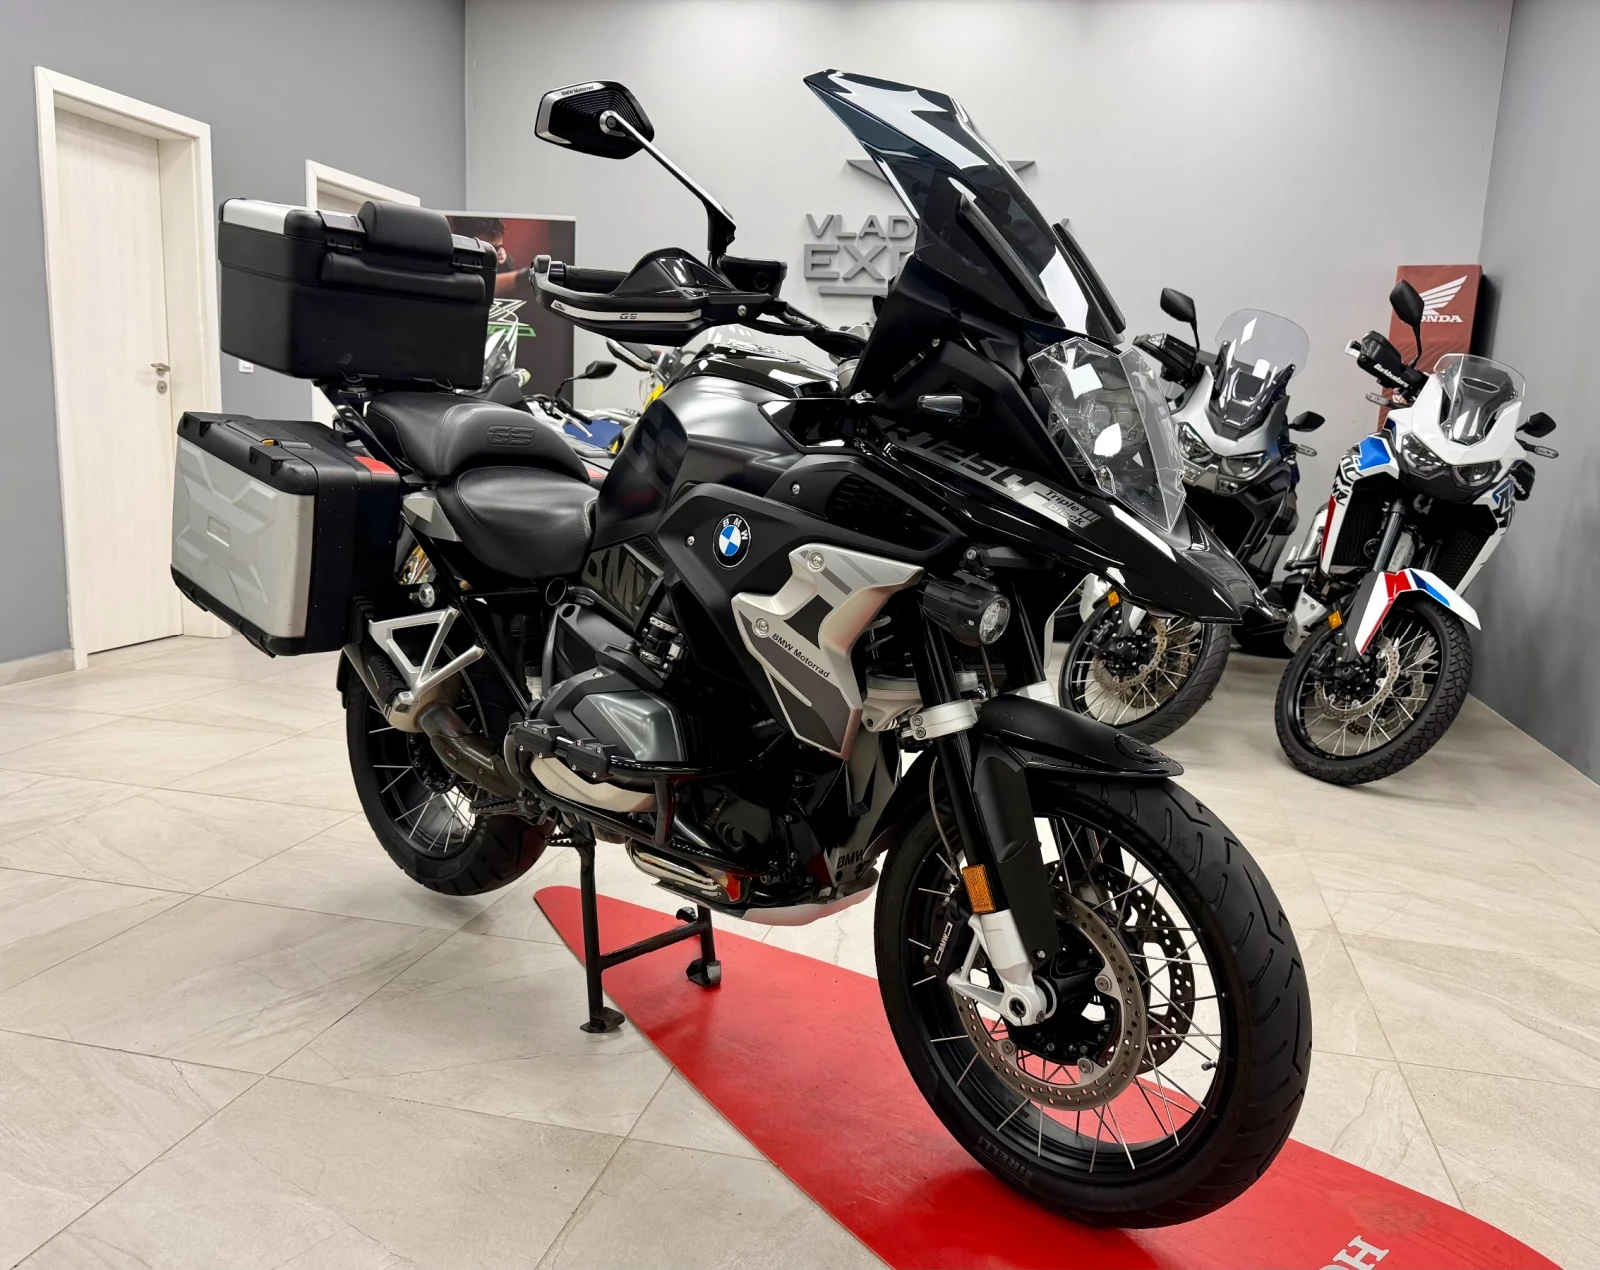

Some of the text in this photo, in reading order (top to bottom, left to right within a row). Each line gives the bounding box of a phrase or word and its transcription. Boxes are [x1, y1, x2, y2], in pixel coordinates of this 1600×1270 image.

[806, 213, 916, 239] VLAD
[1420, 314, 1464, 323] ONDA
[486, 425, 537, 447] GS
[1046, 488, 1080, 512] Triple
[1049, 502, 1086, 526] Black
[722, 517, 749, 541] BMW
[772, 633, 830, 678] BMW Motorrad
